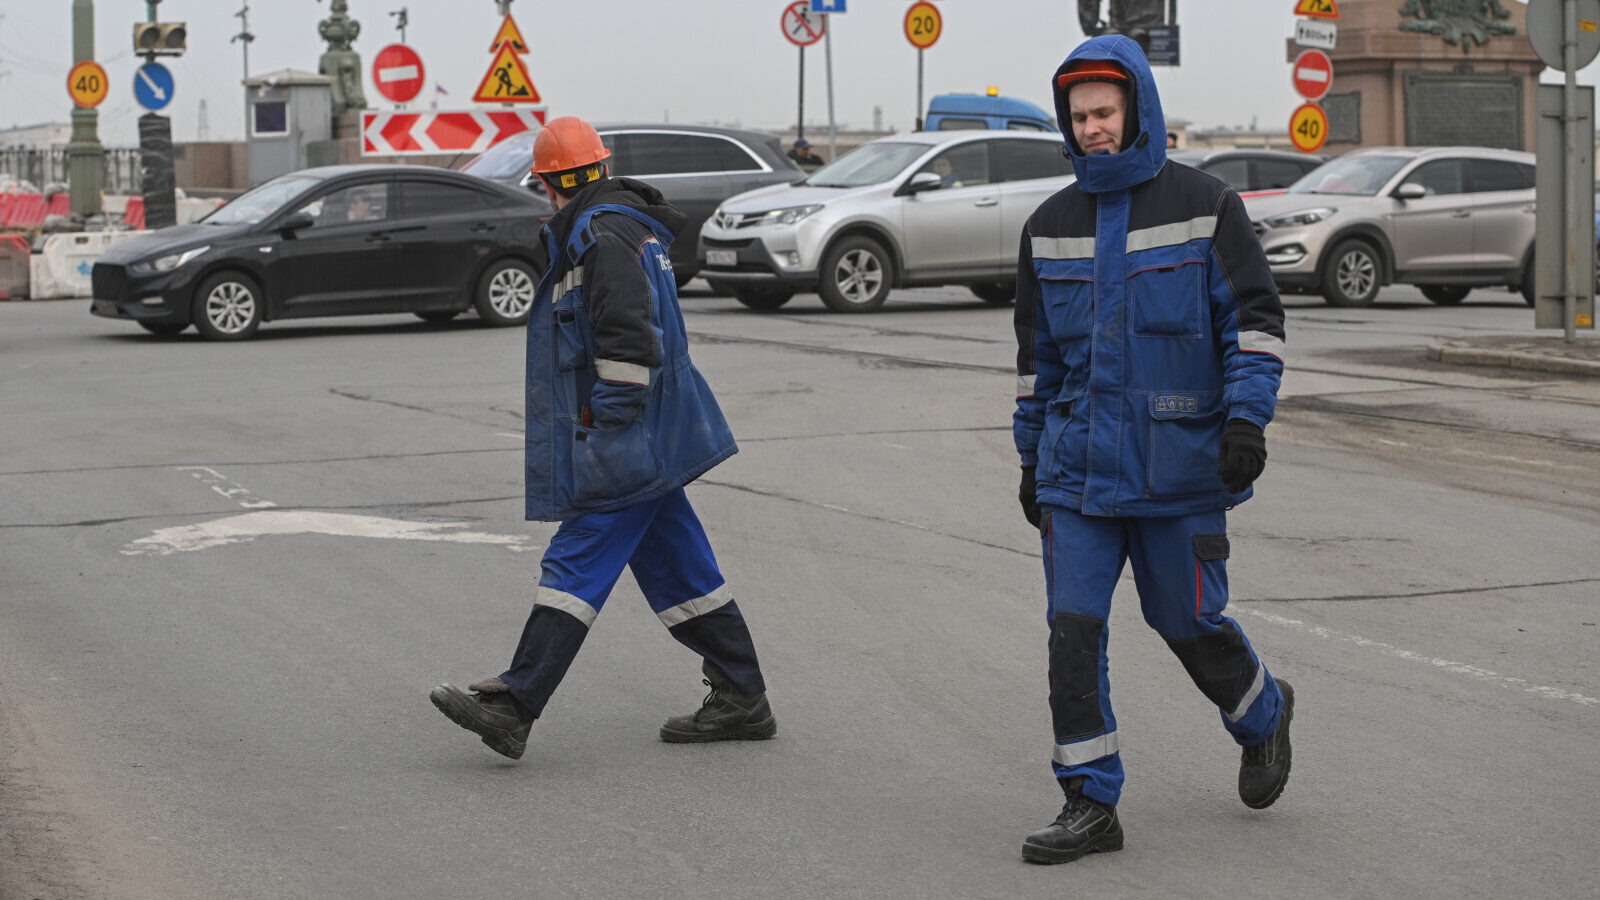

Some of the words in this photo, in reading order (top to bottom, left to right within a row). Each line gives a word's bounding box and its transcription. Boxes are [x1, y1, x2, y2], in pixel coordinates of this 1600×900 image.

[913, 15, 934, 35] 20
[75, 75, 100, 93] 40
[1298, 118, 1320, 138] 40
